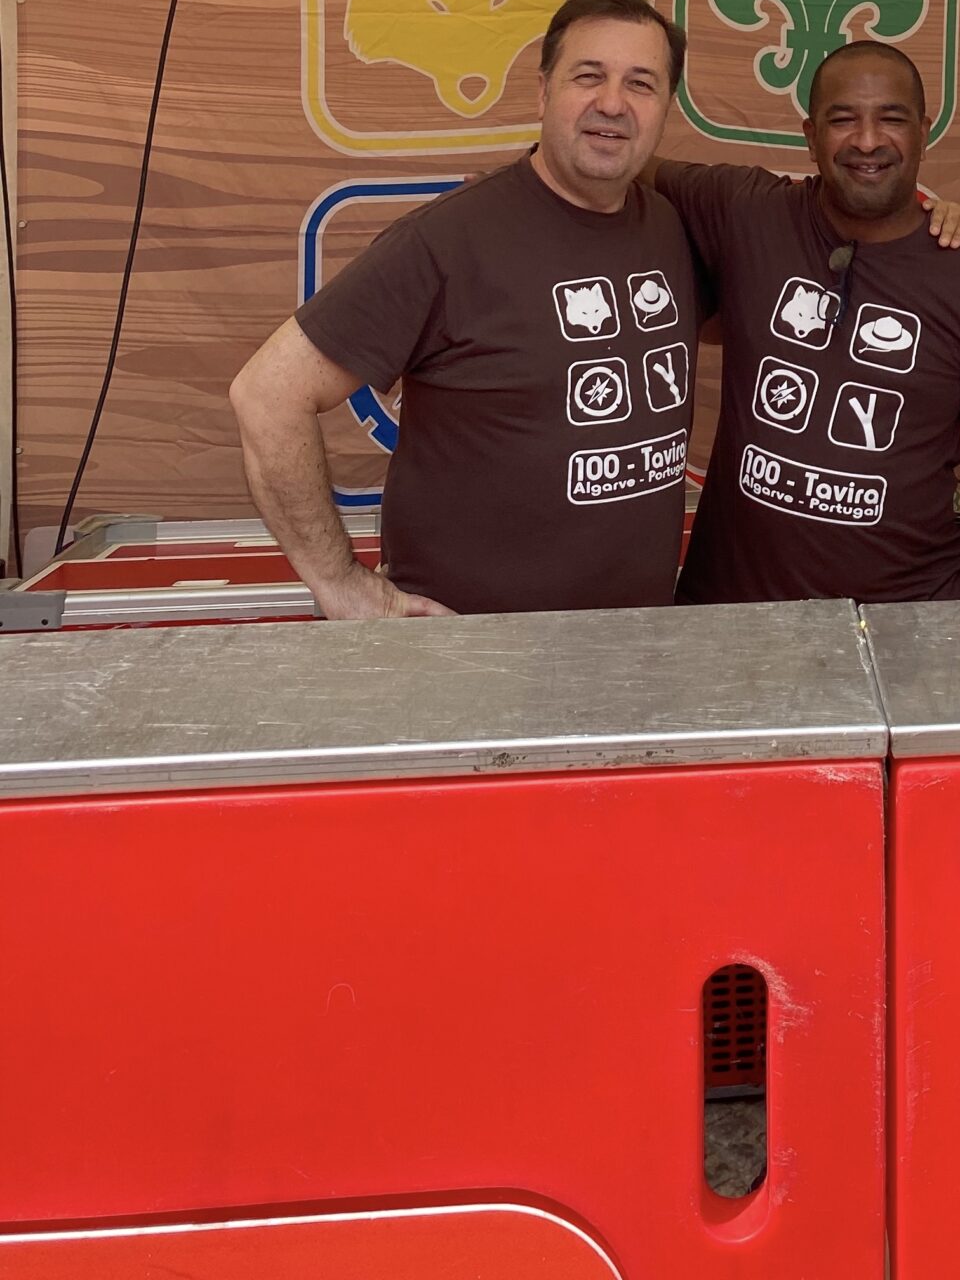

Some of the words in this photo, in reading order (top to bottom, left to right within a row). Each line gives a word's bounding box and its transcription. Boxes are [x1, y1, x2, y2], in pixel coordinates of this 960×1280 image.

[575, 453, 620, 481] 100
[641, 441, 685, 472] Tavira
[745, 449, 781, 486] 100
[805, 471, 879, 505] Tavira
[573, 479, 636, 496] Algarve
[742, 474, 794, 503] Algarve
[809, 497, 879, 519] Portugal
